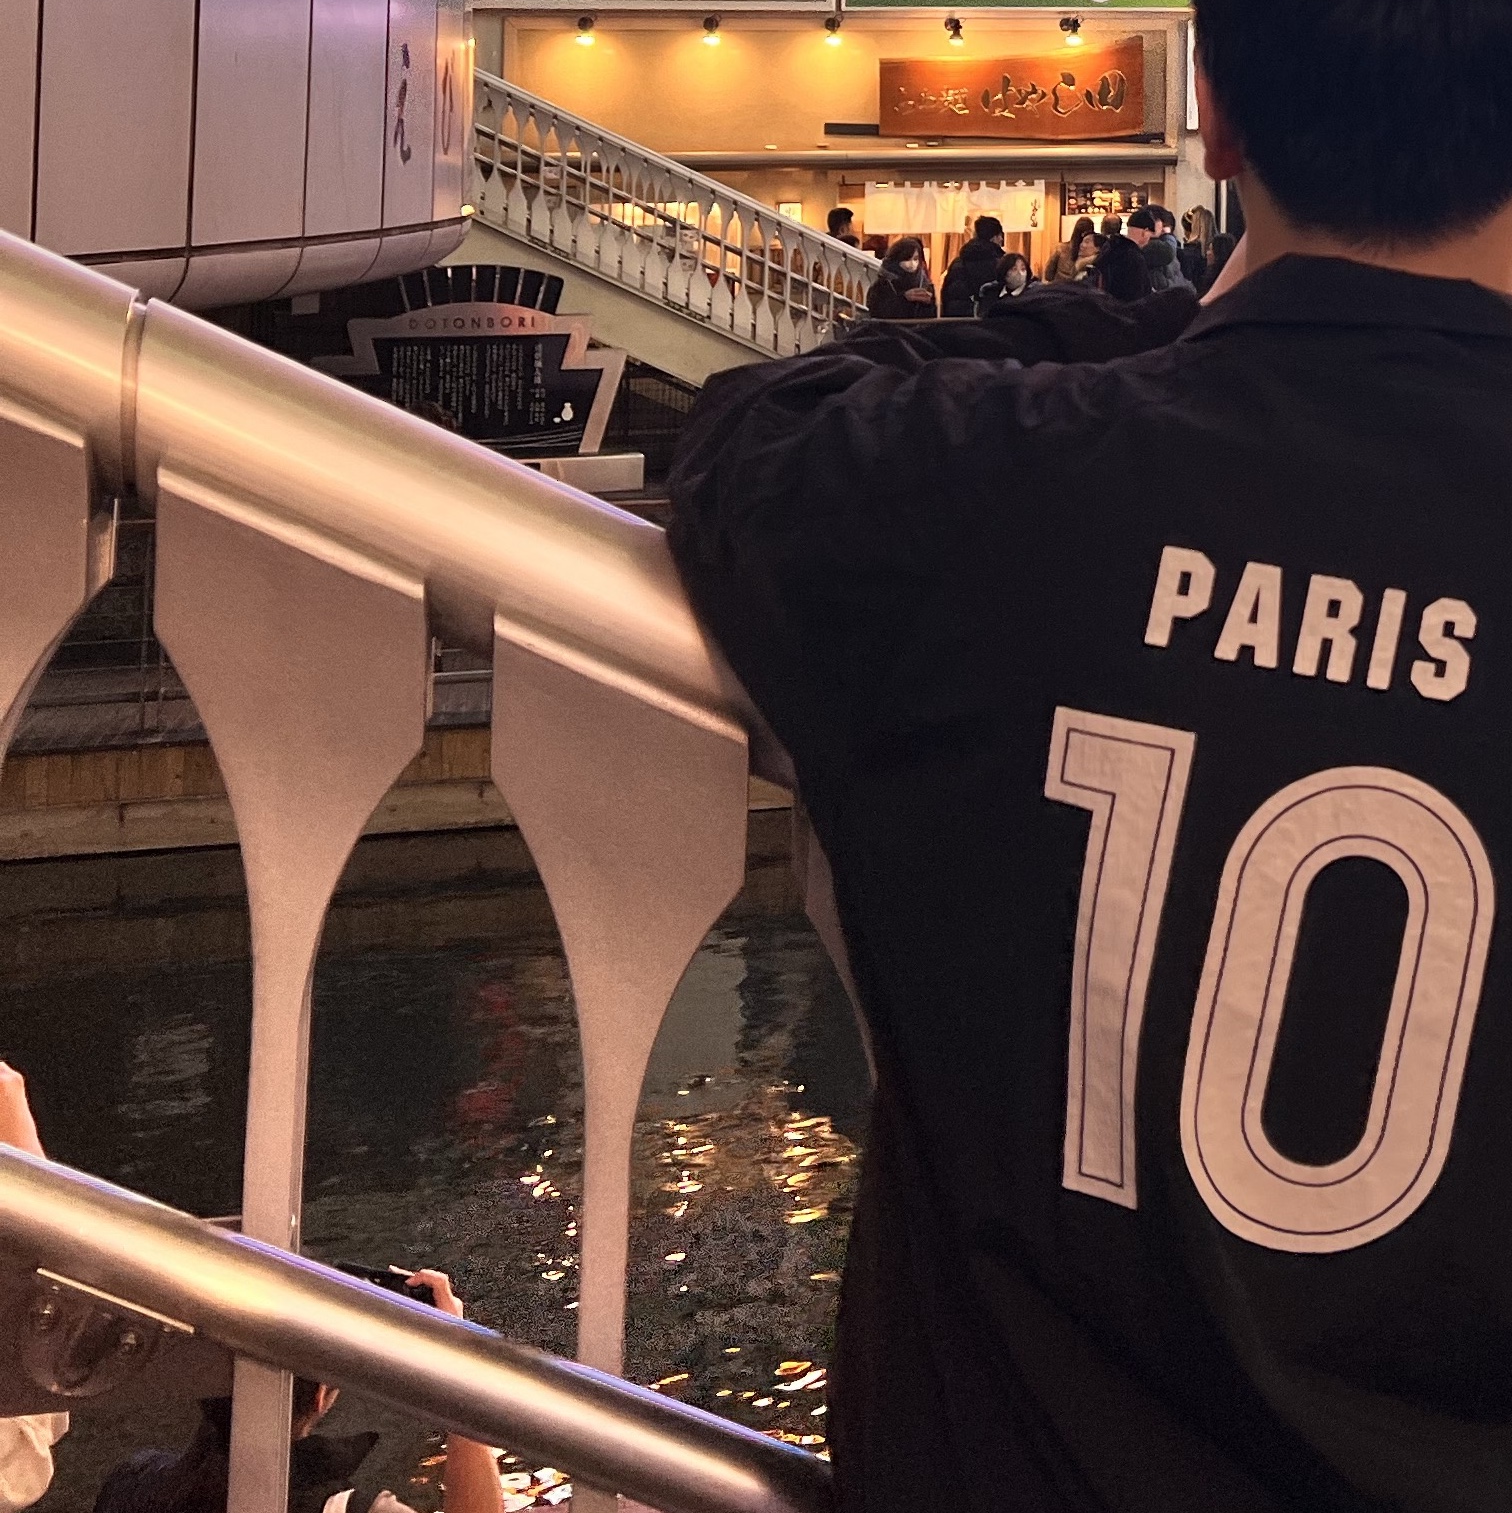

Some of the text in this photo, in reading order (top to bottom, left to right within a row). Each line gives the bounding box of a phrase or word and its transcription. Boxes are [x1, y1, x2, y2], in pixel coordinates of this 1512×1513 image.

[408, 316, 535, 330] DOTONBORI
[1143, 545, 1478, 702] PARIS
[1044, 705, 1496, 1254] 10
